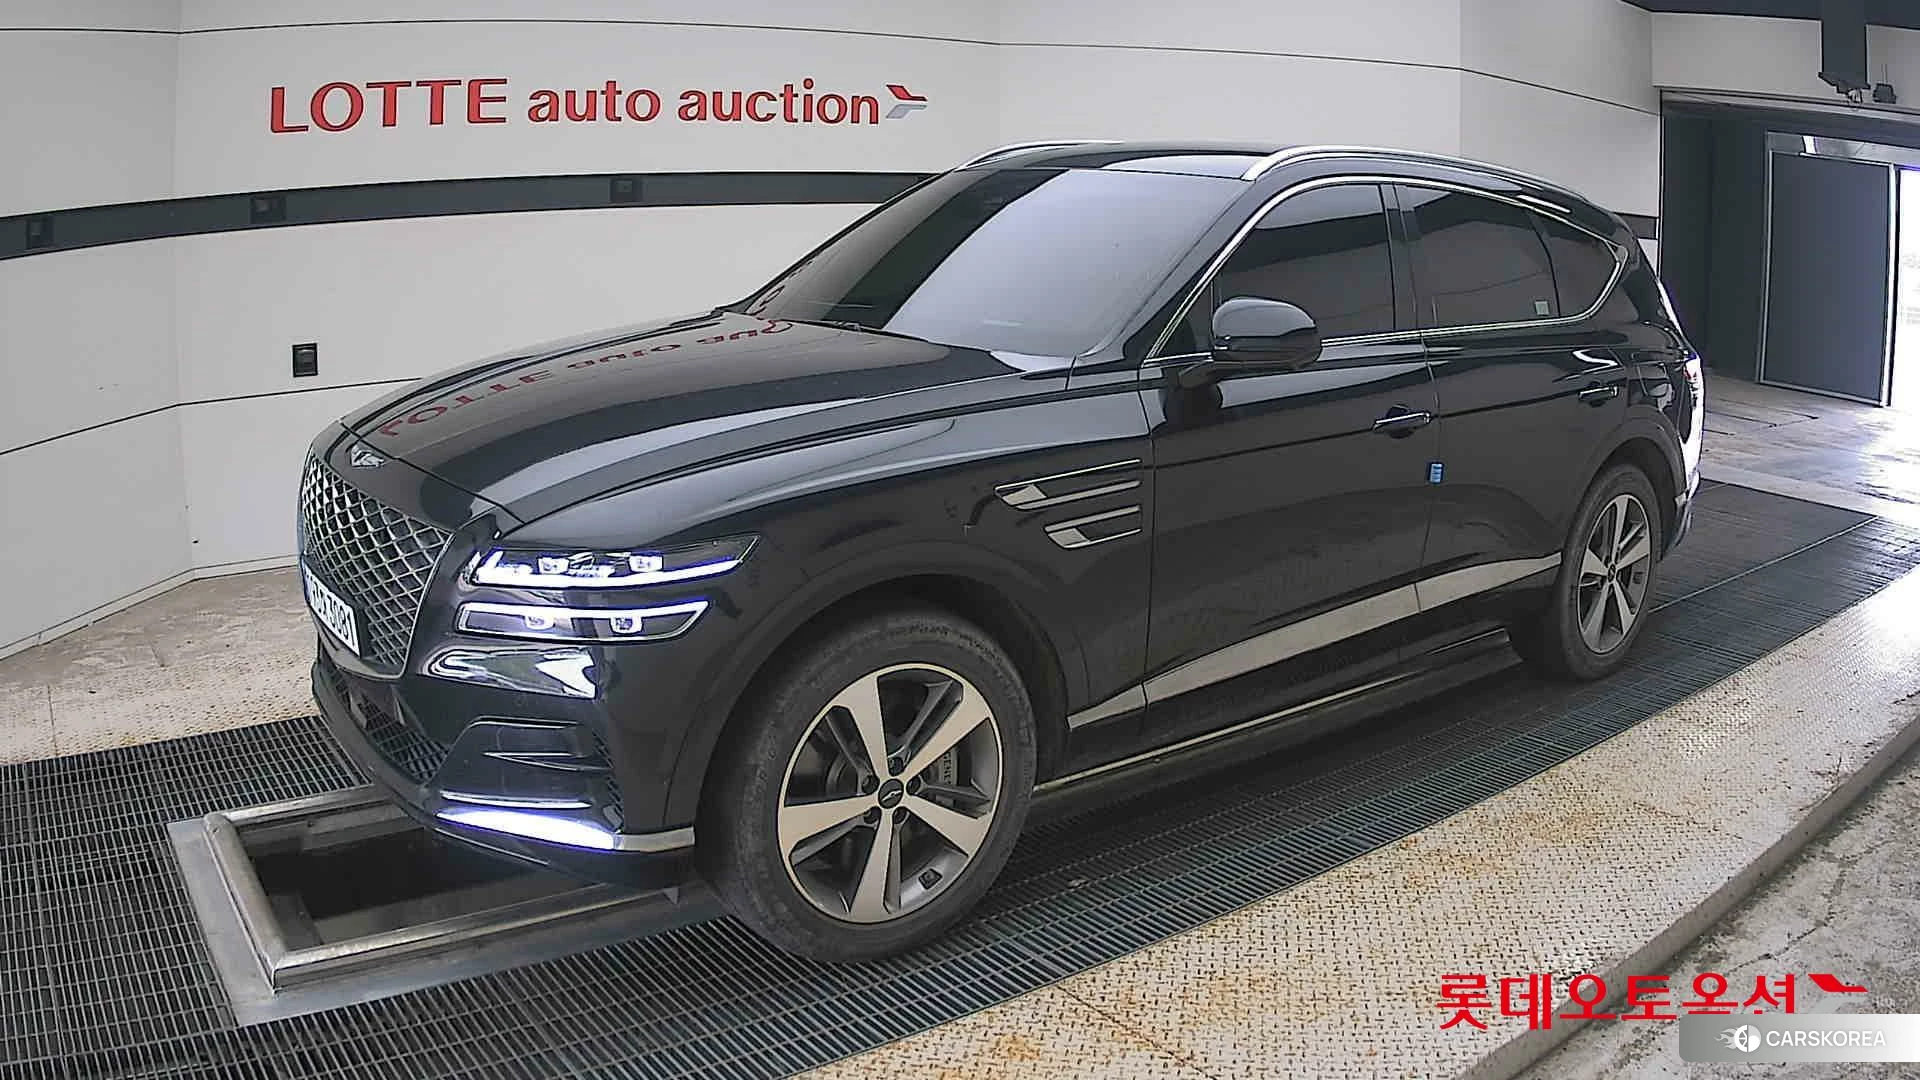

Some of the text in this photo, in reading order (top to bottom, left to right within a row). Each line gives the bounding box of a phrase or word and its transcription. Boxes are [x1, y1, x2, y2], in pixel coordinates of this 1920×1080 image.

[270, 78, 880, 133] LOTTE auto auction
